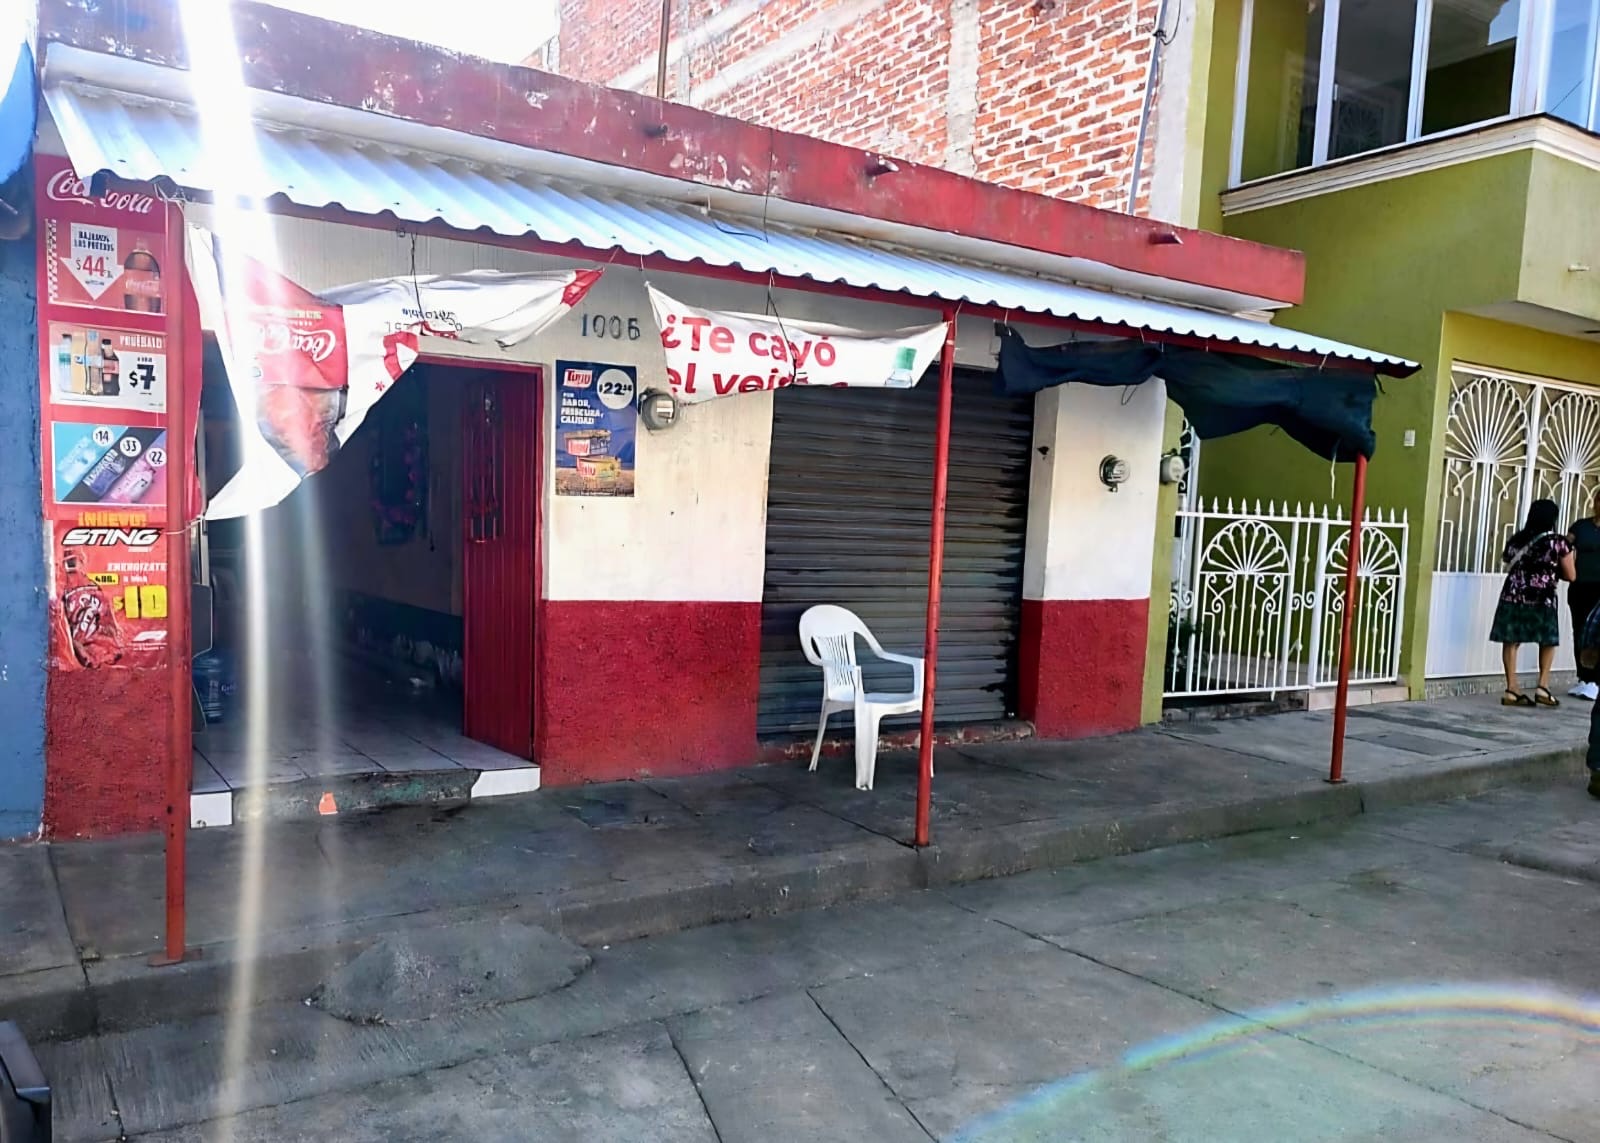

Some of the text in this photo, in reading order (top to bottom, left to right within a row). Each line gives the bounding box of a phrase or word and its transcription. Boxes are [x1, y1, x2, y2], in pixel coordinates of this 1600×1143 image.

[661, 314, 837, 369] ¿Te cayó
[129, 364, 156, 390] $7
[666, 362, 698, 394] el
[62, 527, 161, 546] STING
